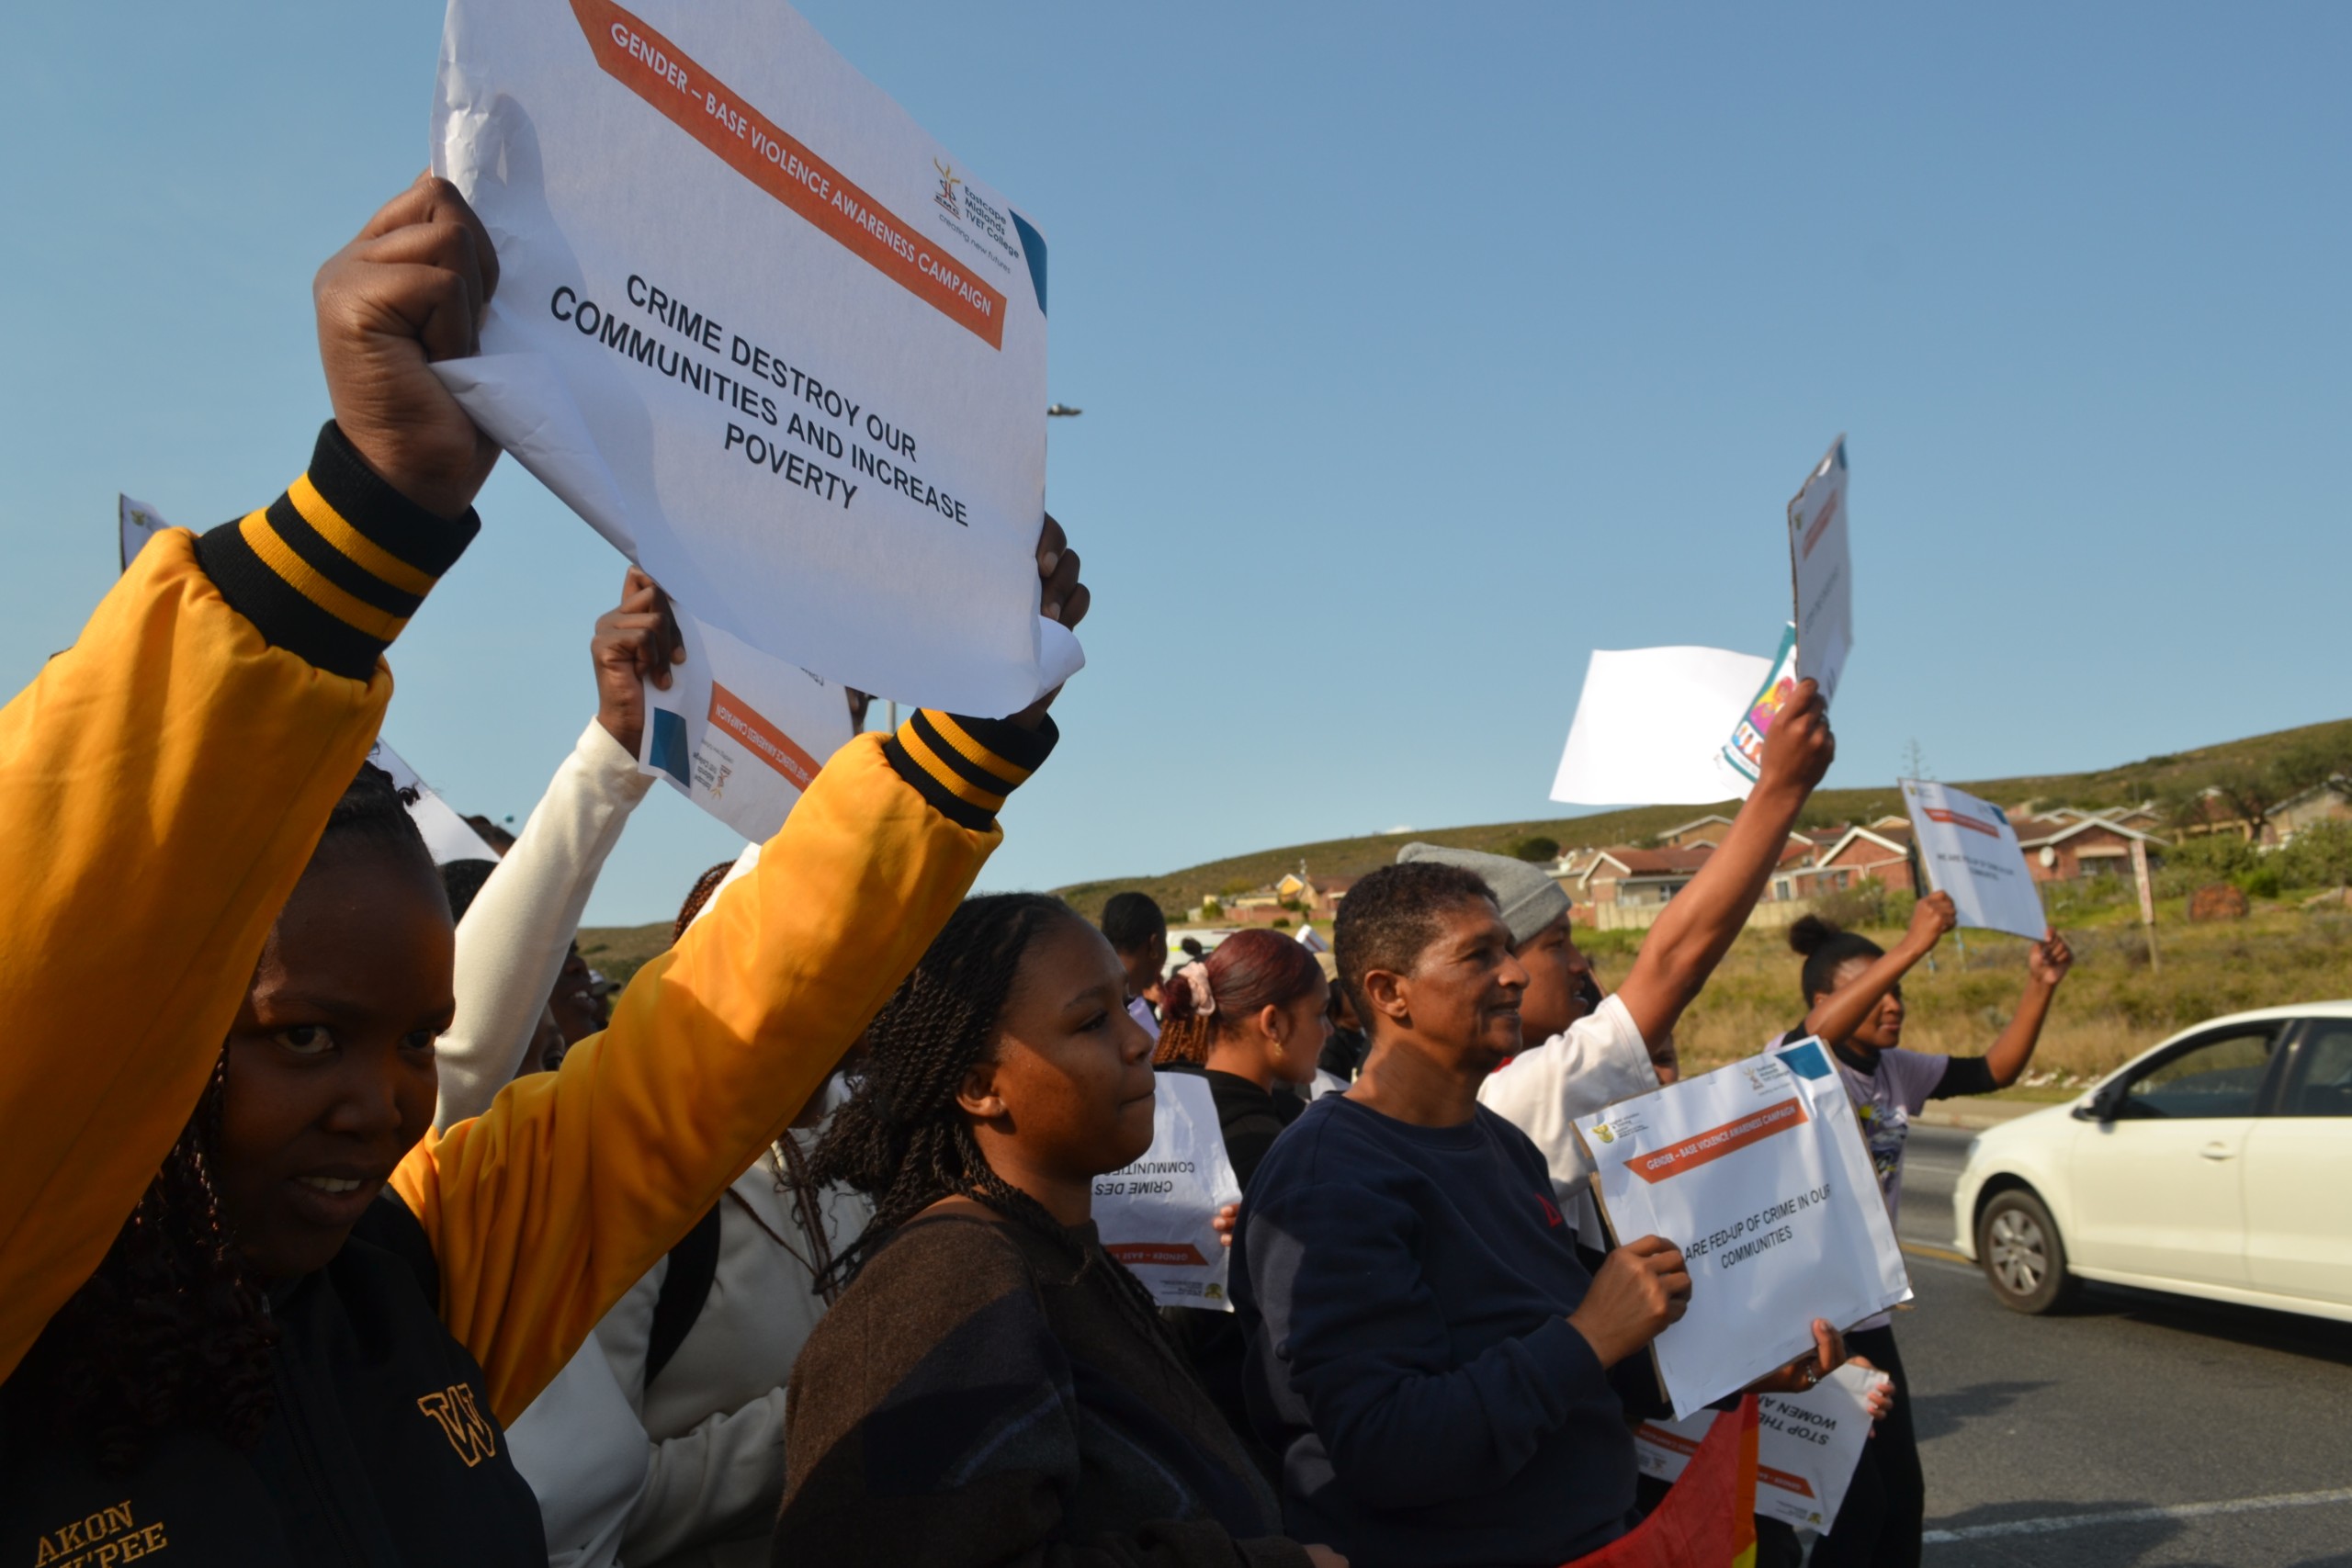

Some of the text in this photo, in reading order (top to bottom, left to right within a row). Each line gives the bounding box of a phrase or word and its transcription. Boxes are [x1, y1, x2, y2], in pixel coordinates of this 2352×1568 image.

[611, 22, 688, 94] GENDER
[706, 91, 748, 139] BASE
[752, 126, 830, 200] VIOLENCE
[831, 190, 915, 263] AWARENESS
[918, 253, 991, 316] CAMPAIGN
[964, 186, 1006, 225] Eastcape
[965, 197, 1005, 235] Midlands
[966, 209, 1020, 258] TVET College
[939, 214, 1011, 274] creating new futures
[627, 274, 917, 463] CRIME DESTROY OUR
[551, 286, 968, 527] COMMUNITIES AND INCREASE
[724, 422, 858, 510] POVERTY
[716, 704, 748, 735] CAMPAIGN
[1646, 1152, 1676, 1170] GENDER
[1679, 1144, 1698, 1158] BASE
[1698, 1132, 1728, 1151] VIOLENCE
[1729, 1118, 1763, 1139] AWARENESS
[1762, 1105, 1795, 1124] CAMPAIGN
[1094, 1180, 1173, 1196] CRIME DES
[1685, 1238, 1709, 1262] ARE
[1709, 1222, 1744, 1251] FED-UP
[1746, 1214, 1761, 1233] OF
[1762, 1200, 1797, 1224] CRIME
[1797, 1193, 1810, 1211] IN
[1721, 1225, 1792, 1269] COMMUNITIES
[418, 1382, 496, 1468] W
[1776, 1402, 1837, 1430] WOMEN
[1787, 1426, 1830, 1446] STOP
[35, 1500, 134, 1568] AKON
